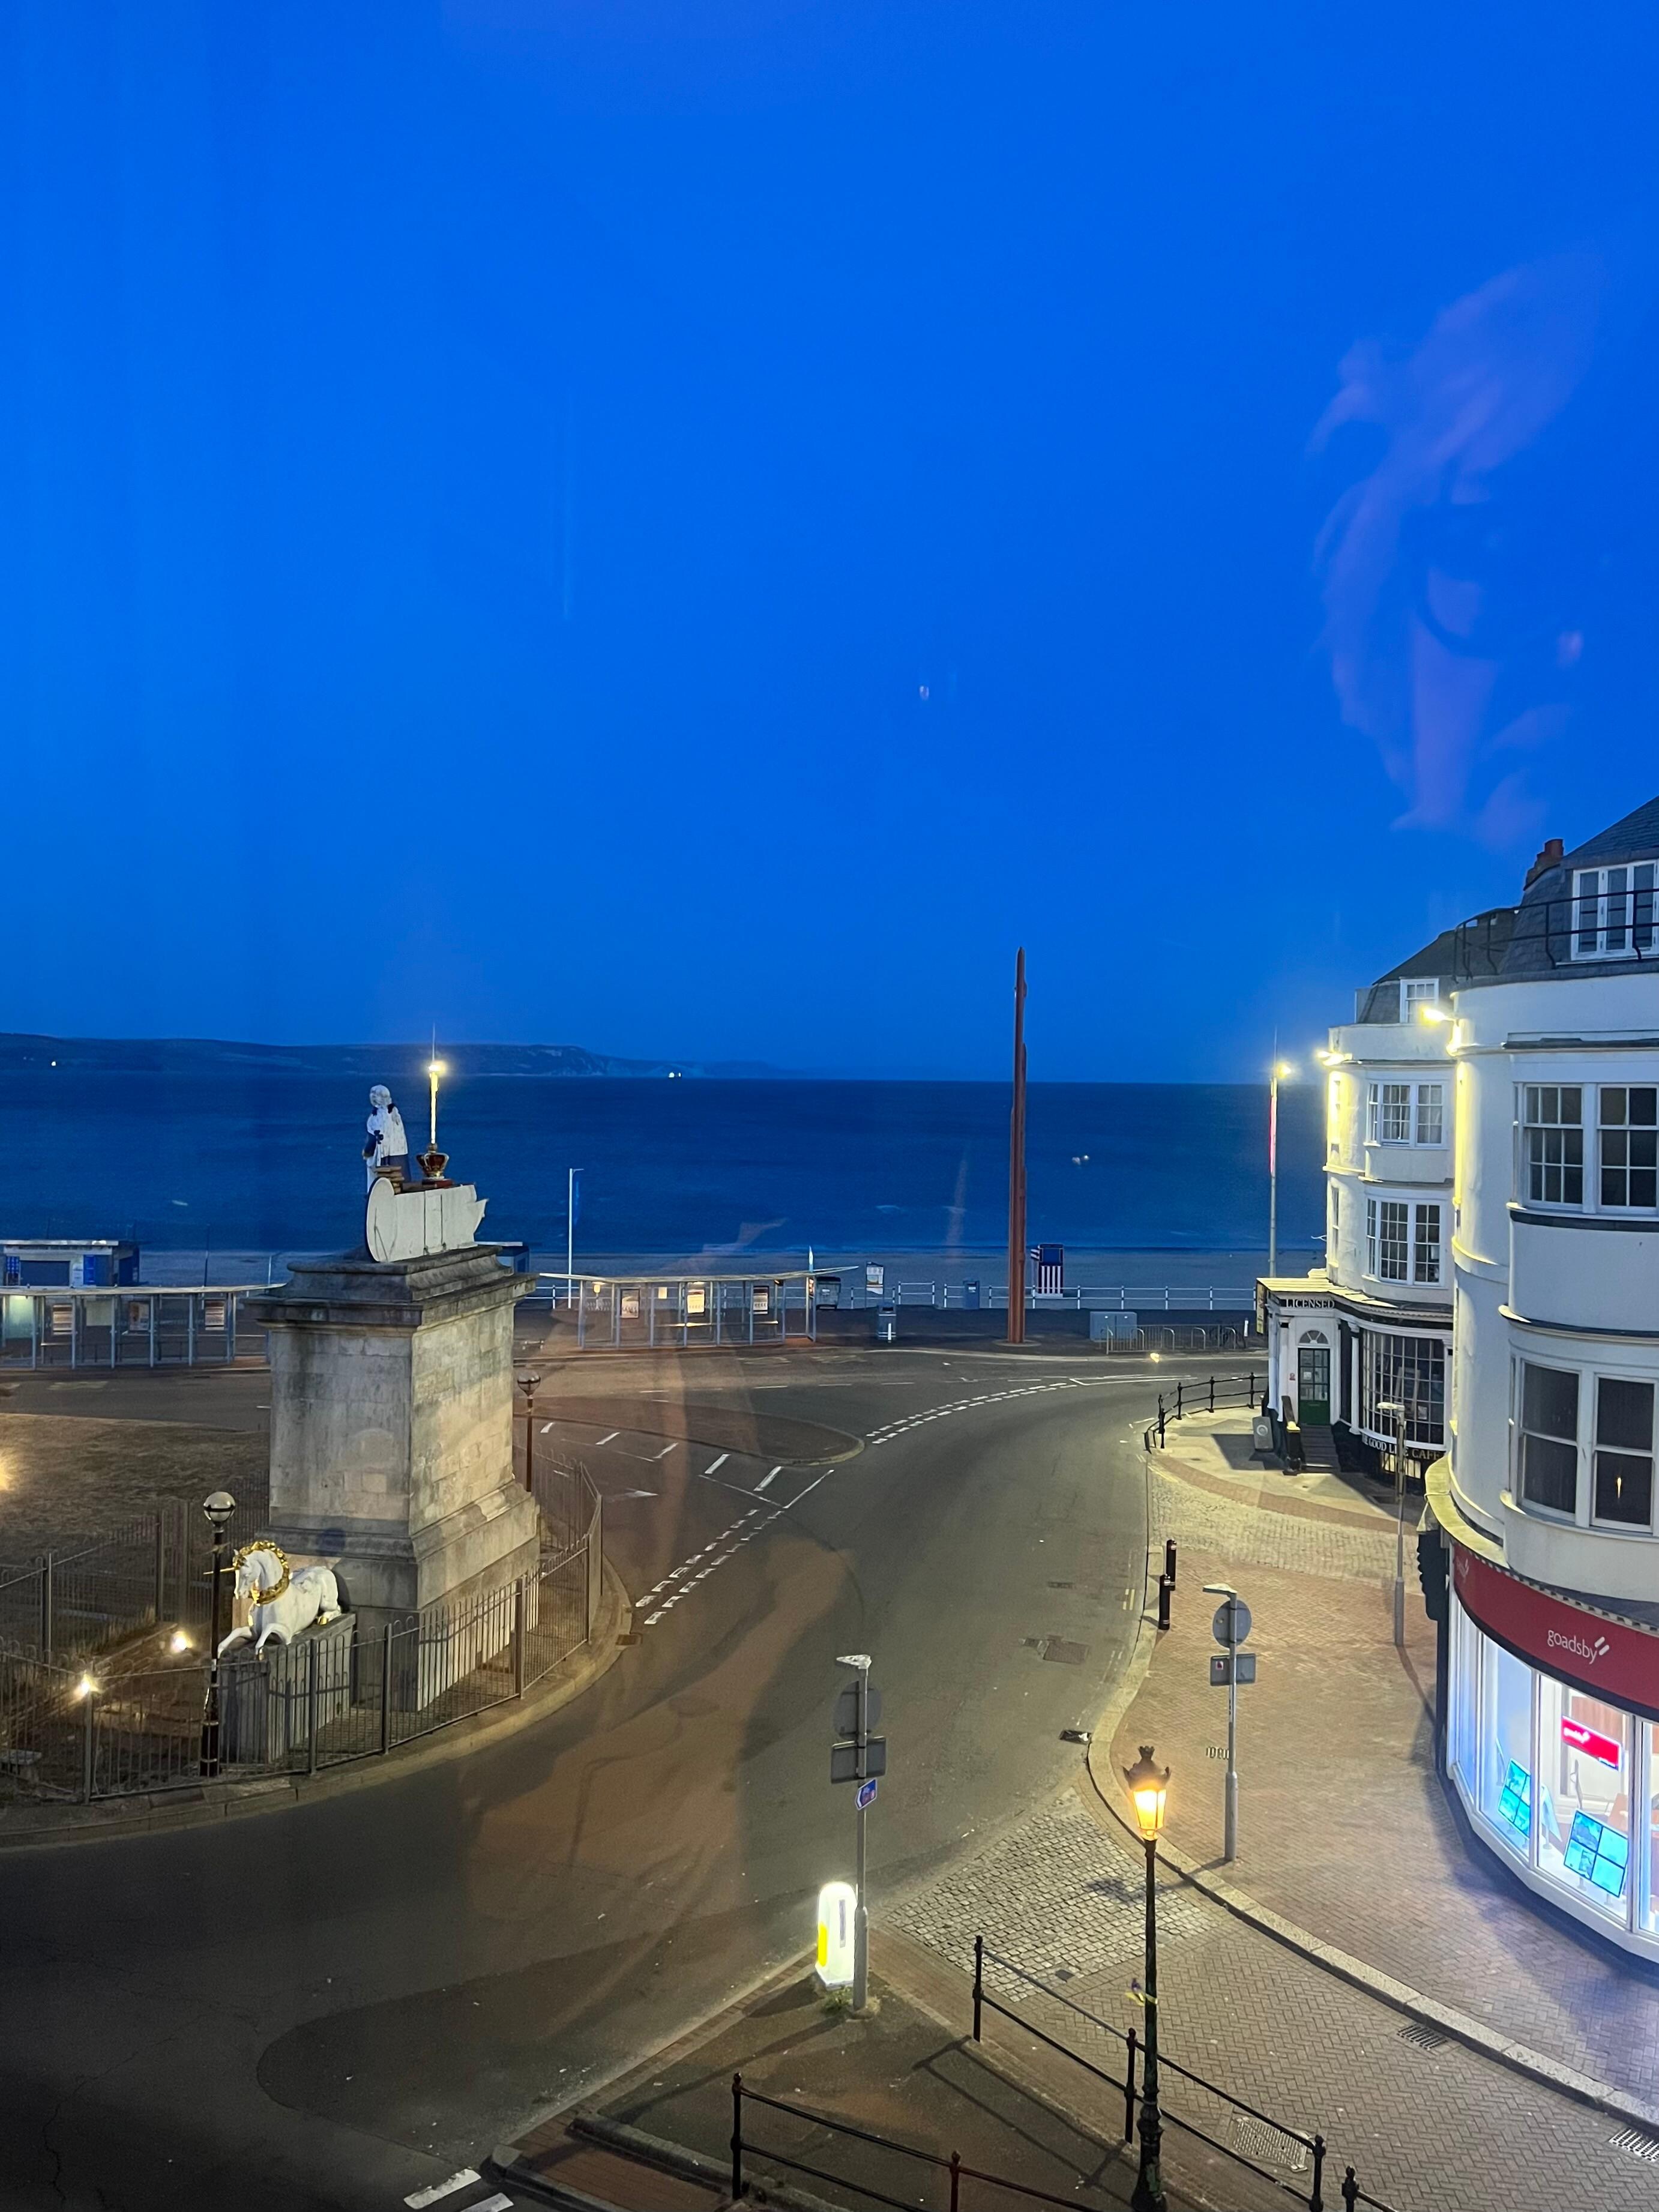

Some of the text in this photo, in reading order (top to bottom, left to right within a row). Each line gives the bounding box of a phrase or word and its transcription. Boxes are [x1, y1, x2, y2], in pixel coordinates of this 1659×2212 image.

[1286, 1298, 1335, 1309] LICENSED
[1368, 1439, 1387, 1451] GOOD
[1389, 1444, 1409, 1456] LIE
[1547, 1630, 1597, 1665] goadsby
